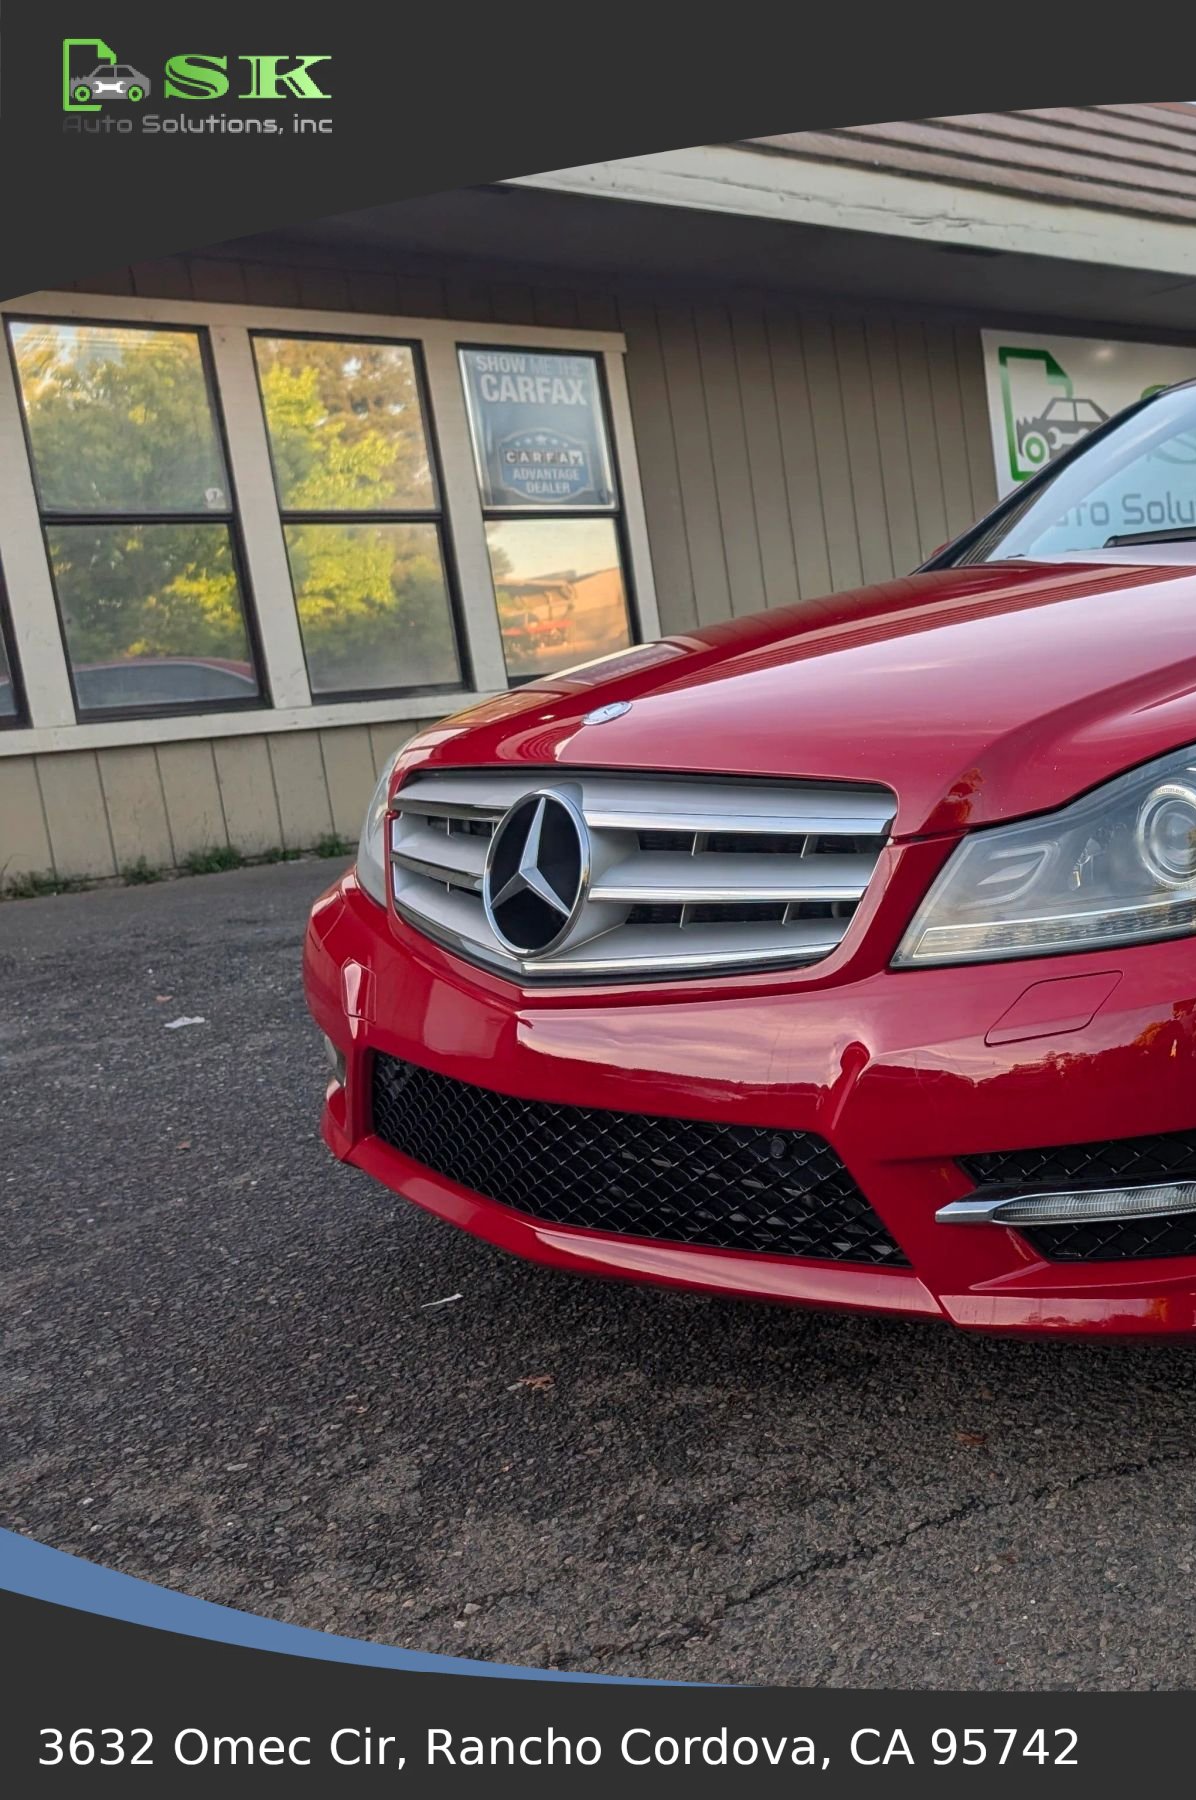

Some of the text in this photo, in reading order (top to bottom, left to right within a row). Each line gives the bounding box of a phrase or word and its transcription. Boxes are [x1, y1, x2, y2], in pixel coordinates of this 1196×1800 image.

[476, 355, 526, 373] SHOW
[480, 374, 588, 405] CARFAX
[513, 468, 579, 480] ADVANTAGE
[526, 481, 570, 494] DEALER
